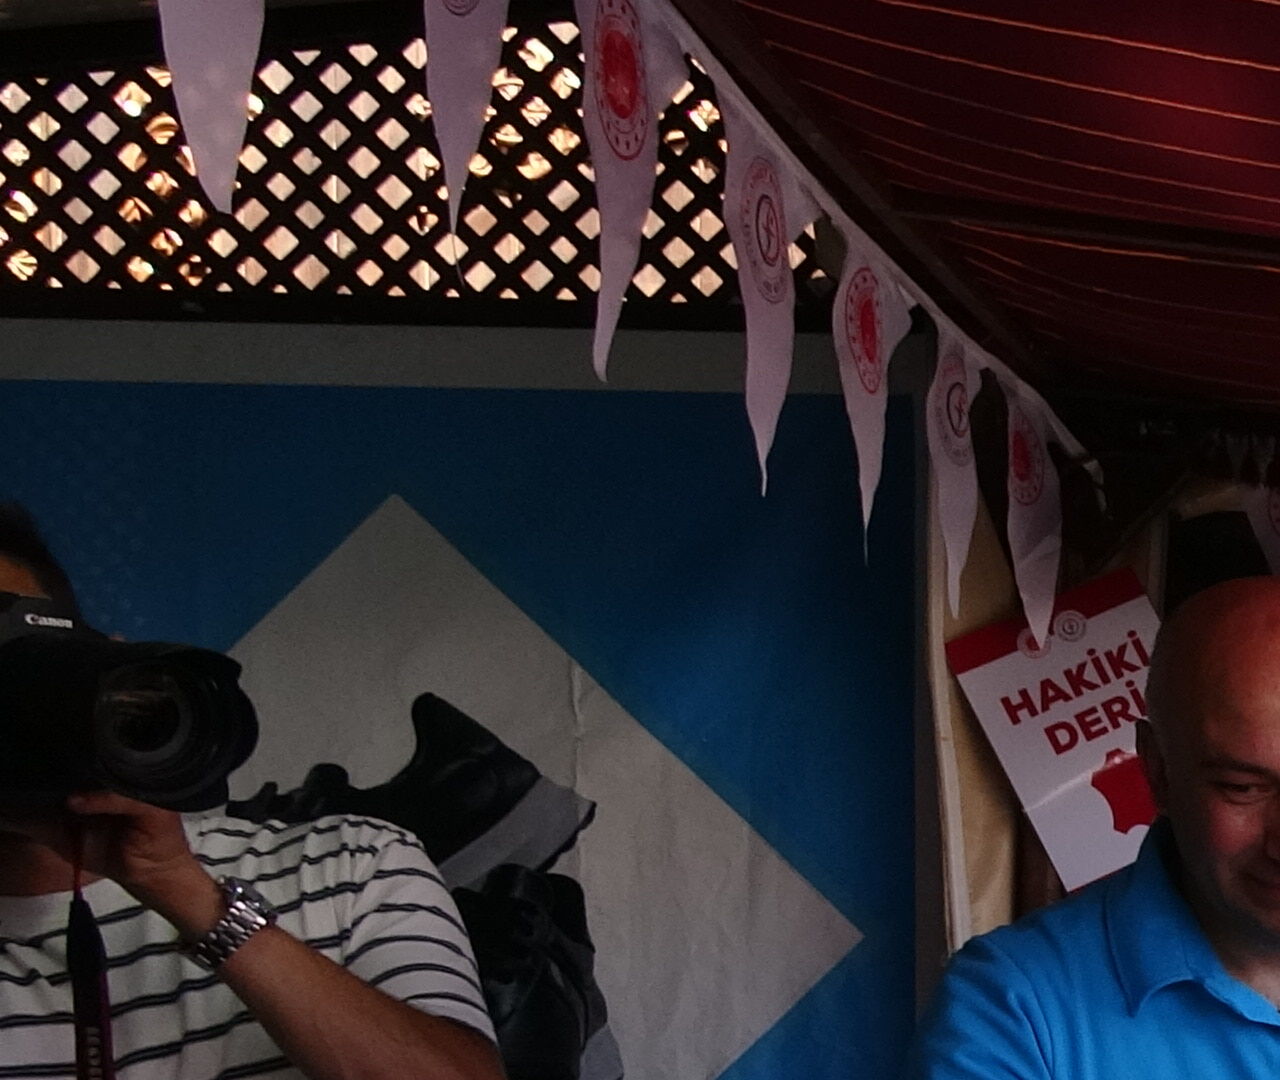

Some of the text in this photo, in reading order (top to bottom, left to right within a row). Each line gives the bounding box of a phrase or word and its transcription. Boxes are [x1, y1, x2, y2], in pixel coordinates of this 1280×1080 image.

[24, 612, 74, 630] Canon
[1000, 629, 1151, 726] HAKİKİ
[1043, 679, 1148, 756] DERİ
